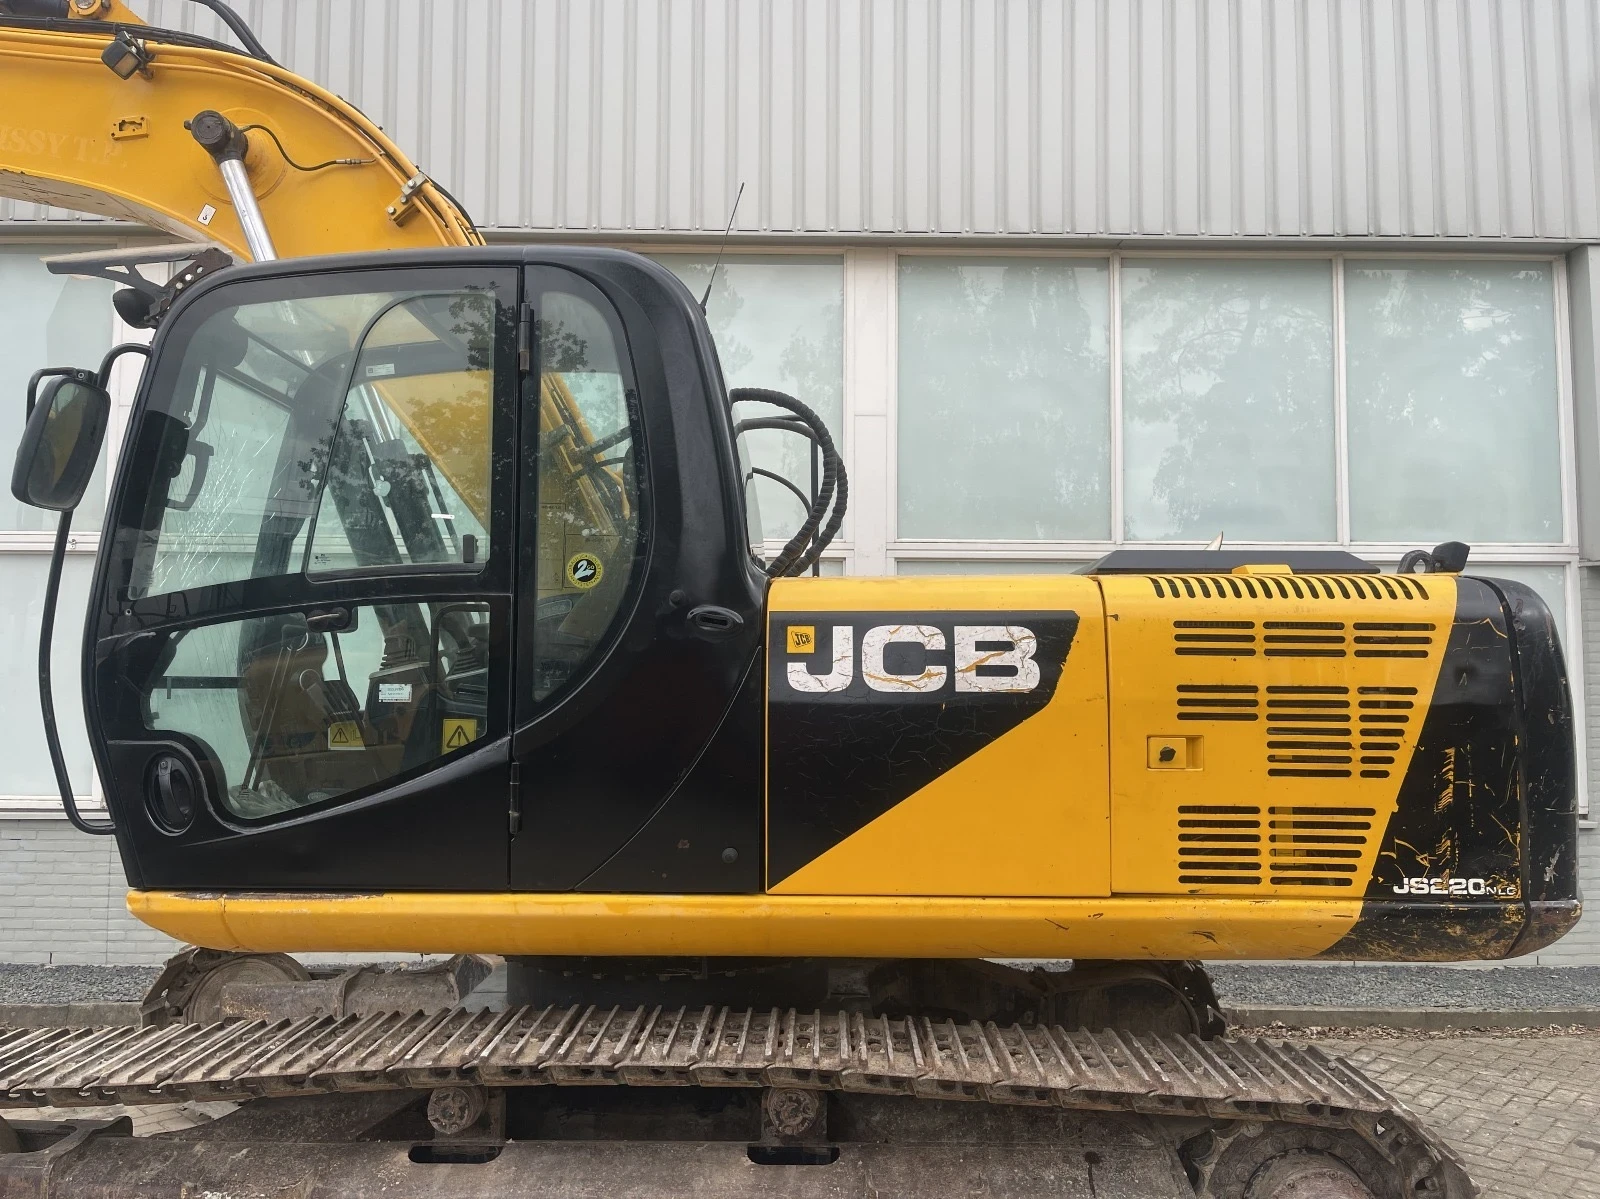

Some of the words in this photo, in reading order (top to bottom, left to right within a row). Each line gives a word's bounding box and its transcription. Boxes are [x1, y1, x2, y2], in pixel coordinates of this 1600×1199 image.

[794, 633, 812, 646] JCB
[787, 625, 1041, 693] JCB
[1393, 878, 1485, 895] JS220
